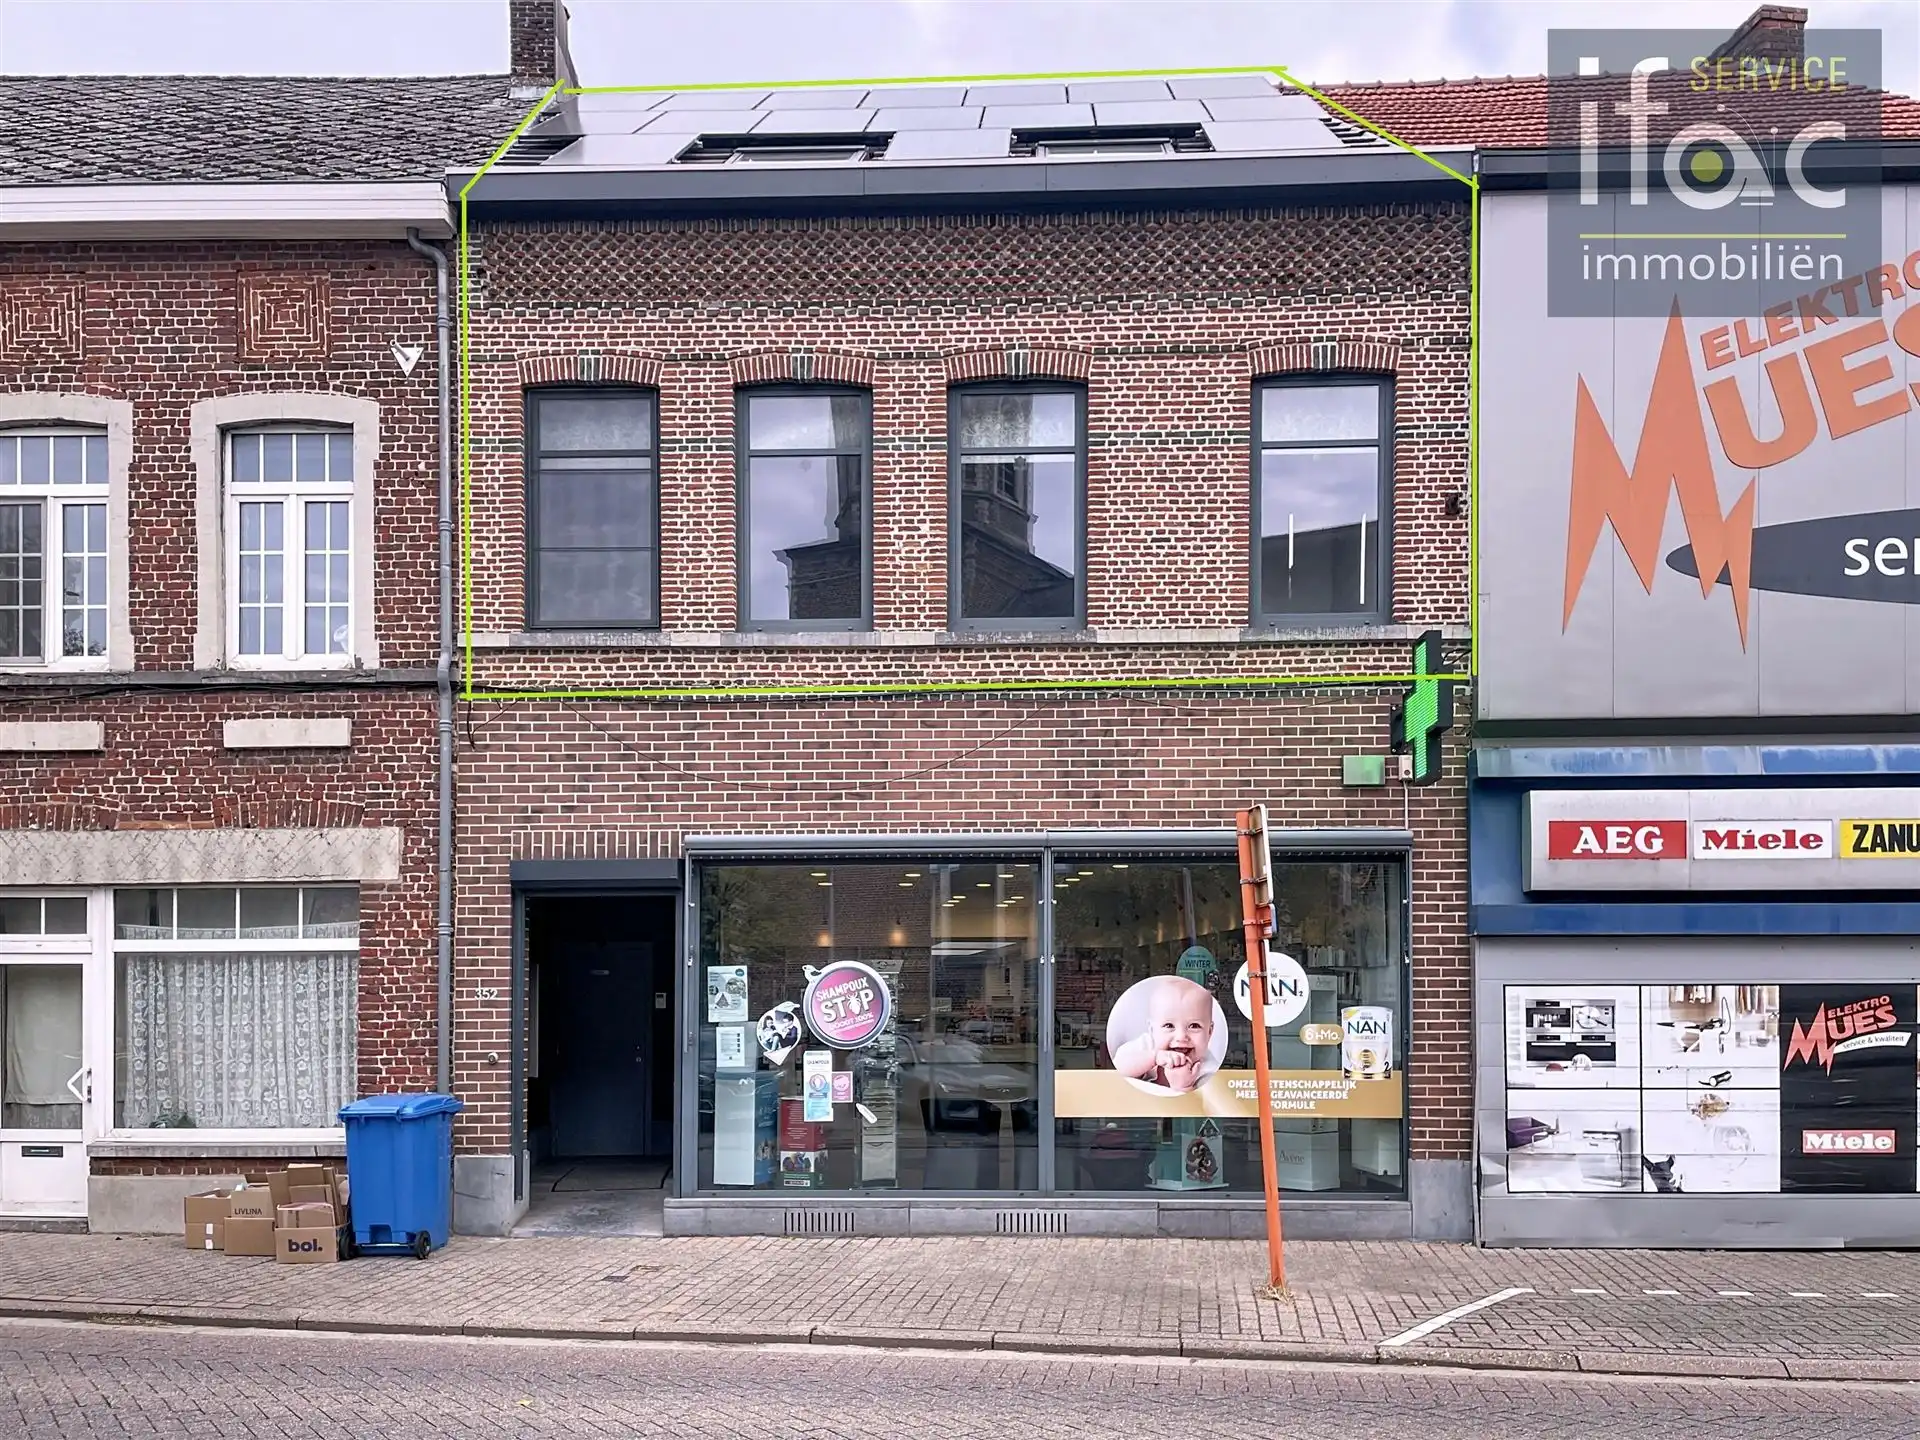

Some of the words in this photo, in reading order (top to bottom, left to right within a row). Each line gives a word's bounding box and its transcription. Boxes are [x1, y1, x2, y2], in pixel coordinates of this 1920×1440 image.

[1562, 293, 1920, 654] MUE
[1573, 826, 1664, 854] AEG
[1702, 828, 1824, 850] Miele
[1184, 959, 1211, 968] WINTER
[474, 988, 498, 1000] 352
[816, 977, 869, 1002] SHAMPOUX
[1827, 995, 1890, 1019] ELEKTRO
[1305, 1027, 1315, 1041] 6
[1347, 1020, 1386, 1035] NAN
[1783, 1001, 1897, 1078] MUES
[1843, 1039, 1866, 1049] service
[1867, 1036, 1873, 1044] &
[1384, 1061, 1390, 1072] 2
[1270, 1090, 1348, 1100] GEAVANCEERDE
[1805, 1132, 1893, 1150] Miele
[288, 1239, 323, 1252] bol.
